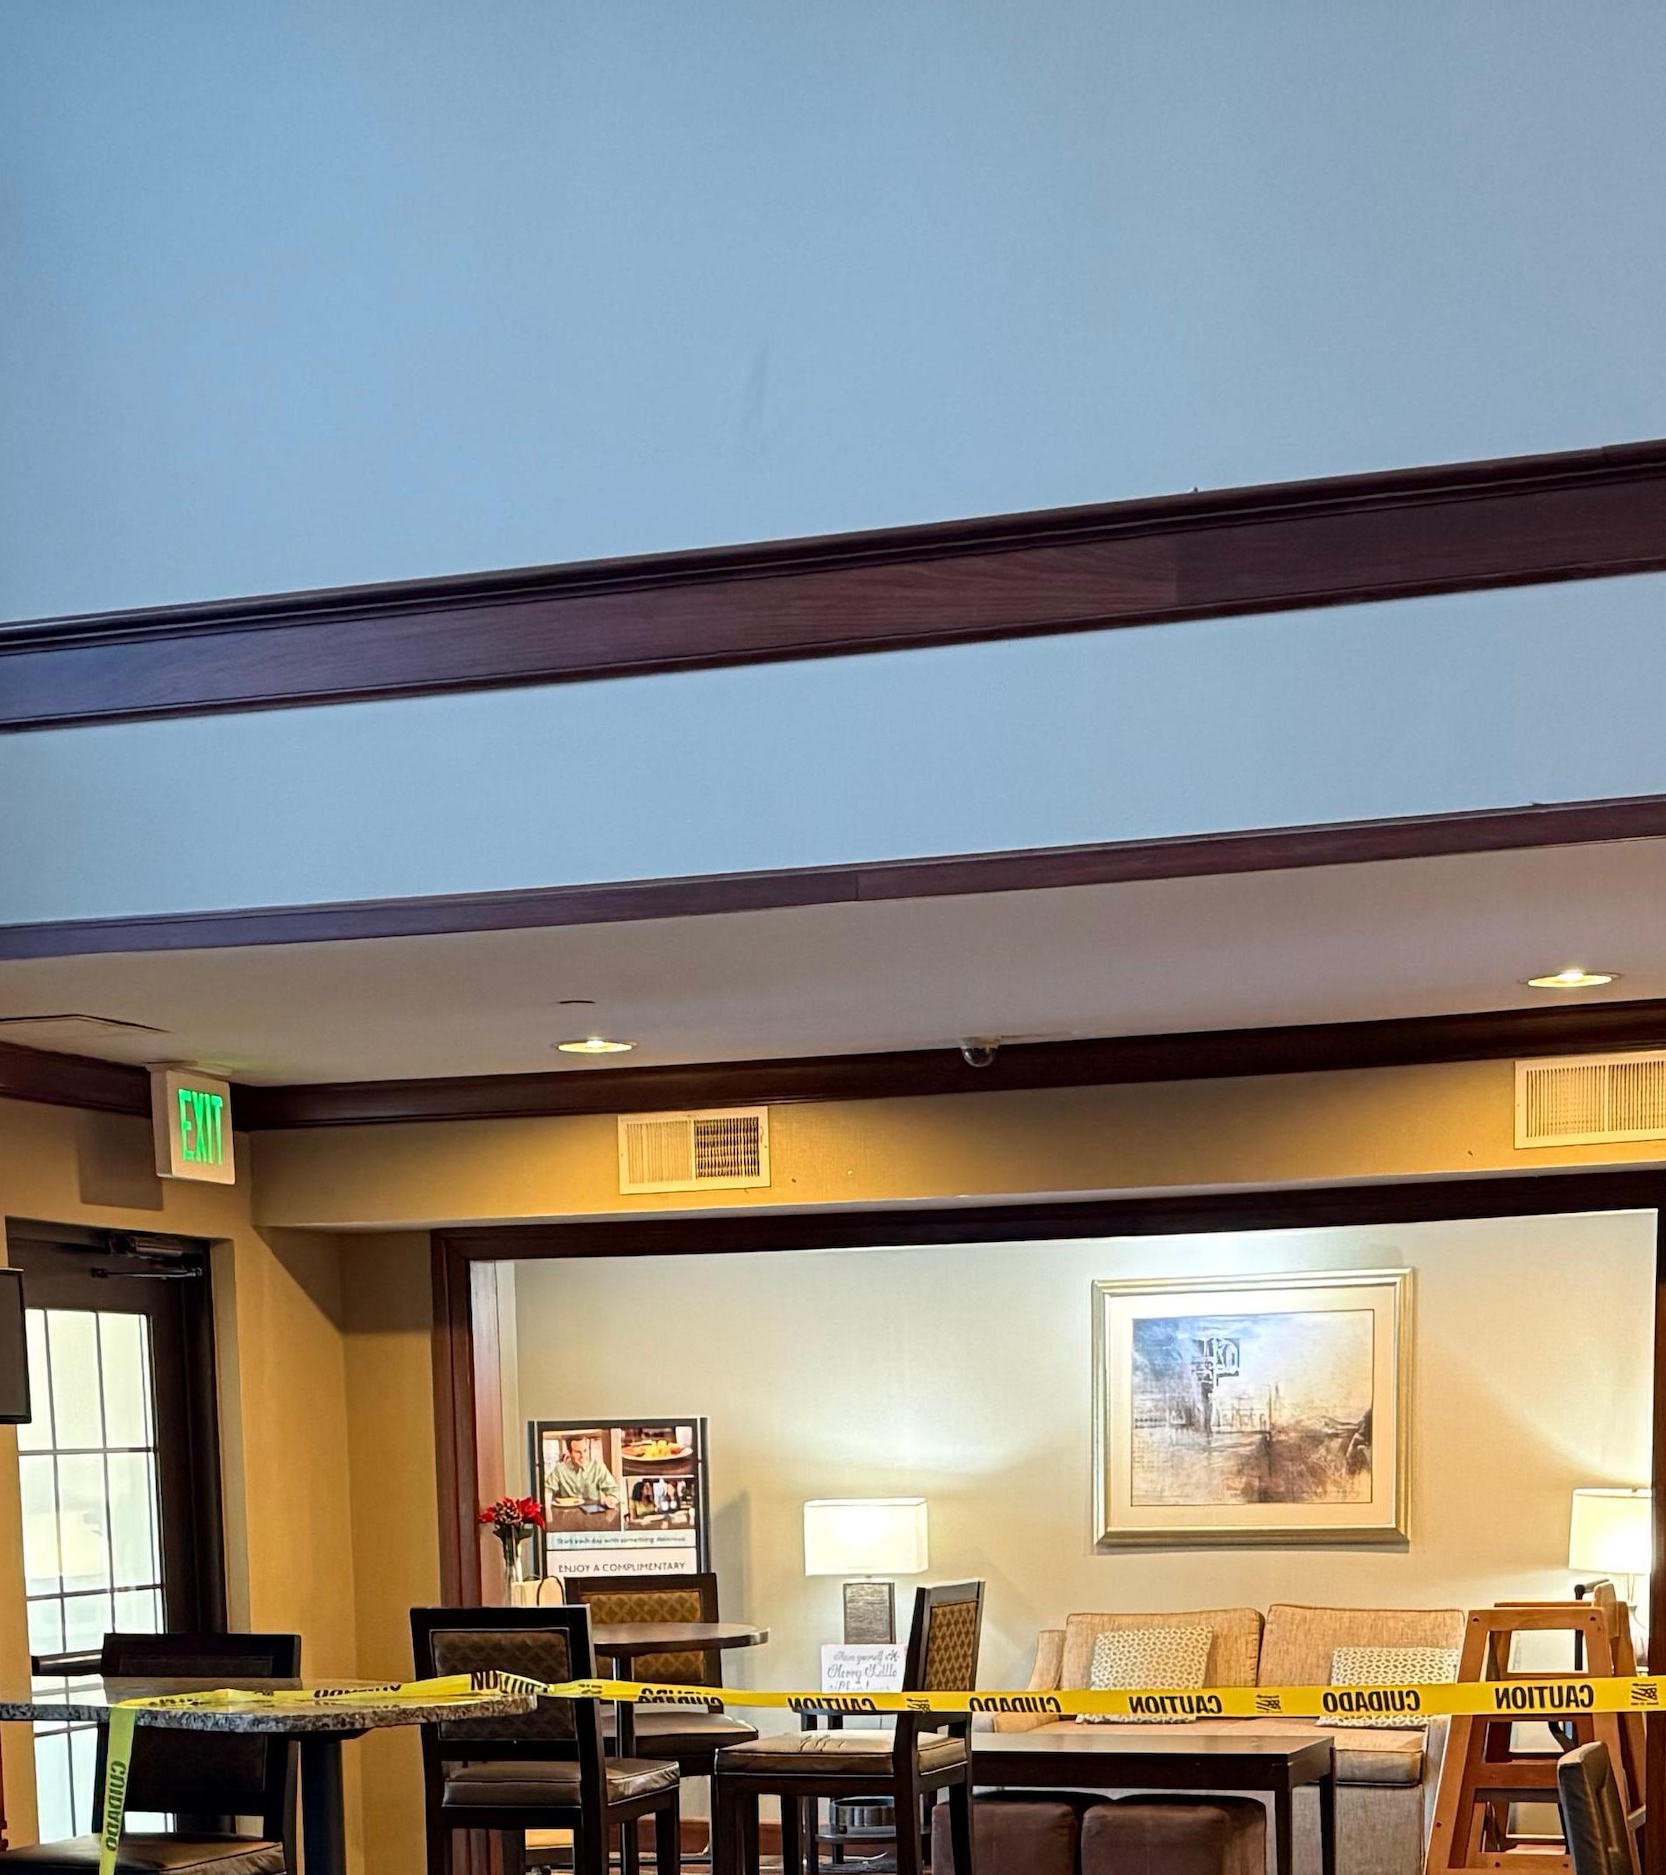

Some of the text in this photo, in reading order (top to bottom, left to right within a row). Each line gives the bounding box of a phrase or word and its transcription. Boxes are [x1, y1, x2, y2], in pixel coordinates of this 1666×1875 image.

[178, 1088, 223, 1166] EXIT
[558, 1562, 685, 1573] ENJOY A COMPLIMENTARY
